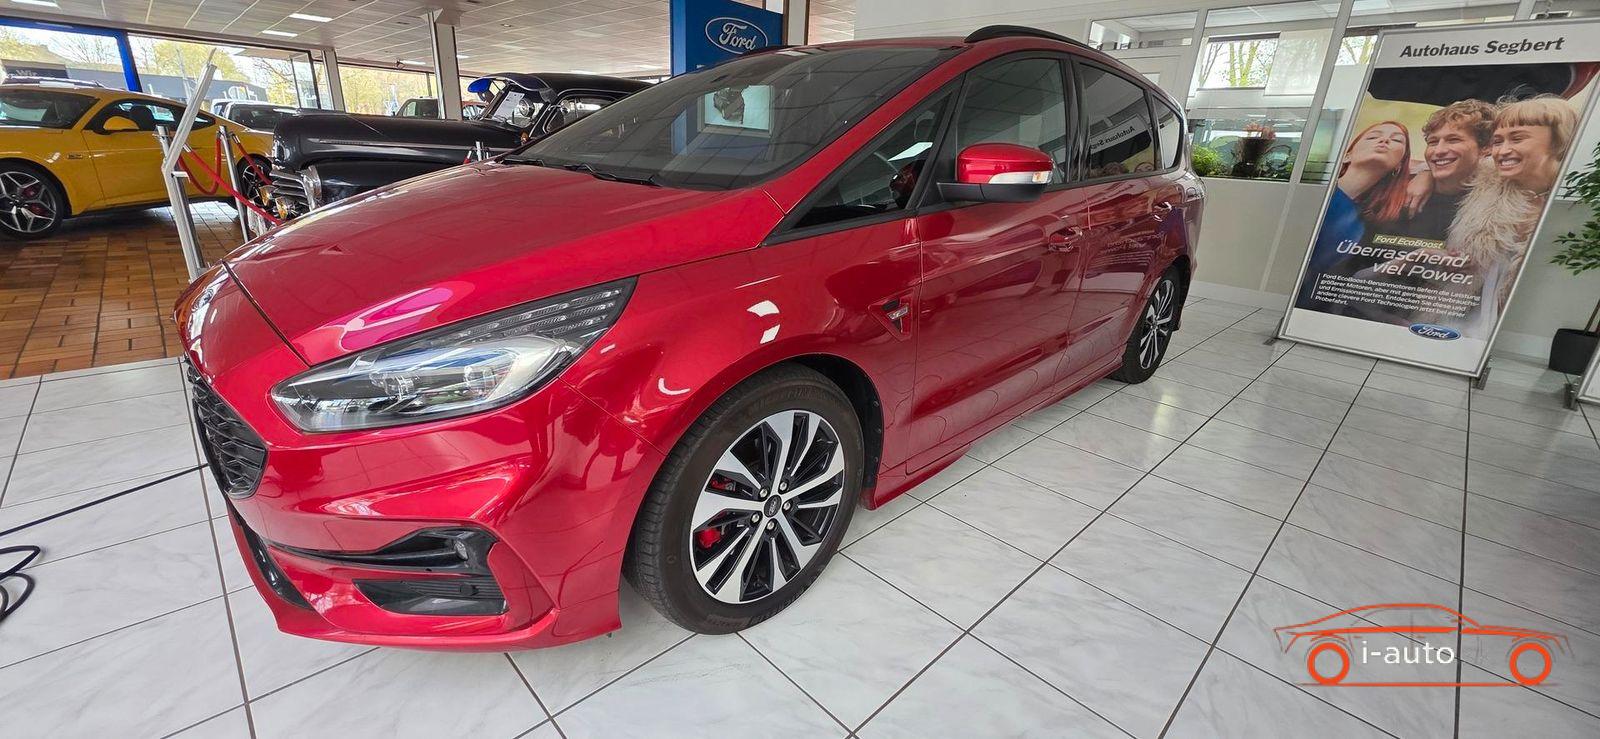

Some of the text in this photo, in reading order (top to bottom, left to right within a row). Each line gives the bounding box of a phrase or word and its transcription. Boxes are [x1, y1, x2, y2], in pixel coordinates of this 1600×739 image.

[719, 22, 758, 51] Ford
[1399, 36, 1565, 58] Autohaus Segbert
[1375, 235, 1444, 249] Ford EcoBoost
[1335, 239, 1470, 268] Überraschend
[1372, 262, 1474, 285] viel Power.
[1315, 295, 1349, 306] Probefahrt.
[1316, 290, 1338, 298] andere
[1338, 293, 1360, 301] clevere
[1377, 298, 1419, 311] Technologien
[1419, 306, 1435, 314] jetzt
[1320, 279, 1346, 288] größerer
[1402, 291, 1437, 301] geringeren
[1438, 296, 1480, 307] Verbrauchs-
[1386, 294, 1420, 305] Entdecken
[1432, 301, 1452, 309] diese
[1417, 286, 1438, 295] liefern
[1450, 291, 1481, 302] Leistung
